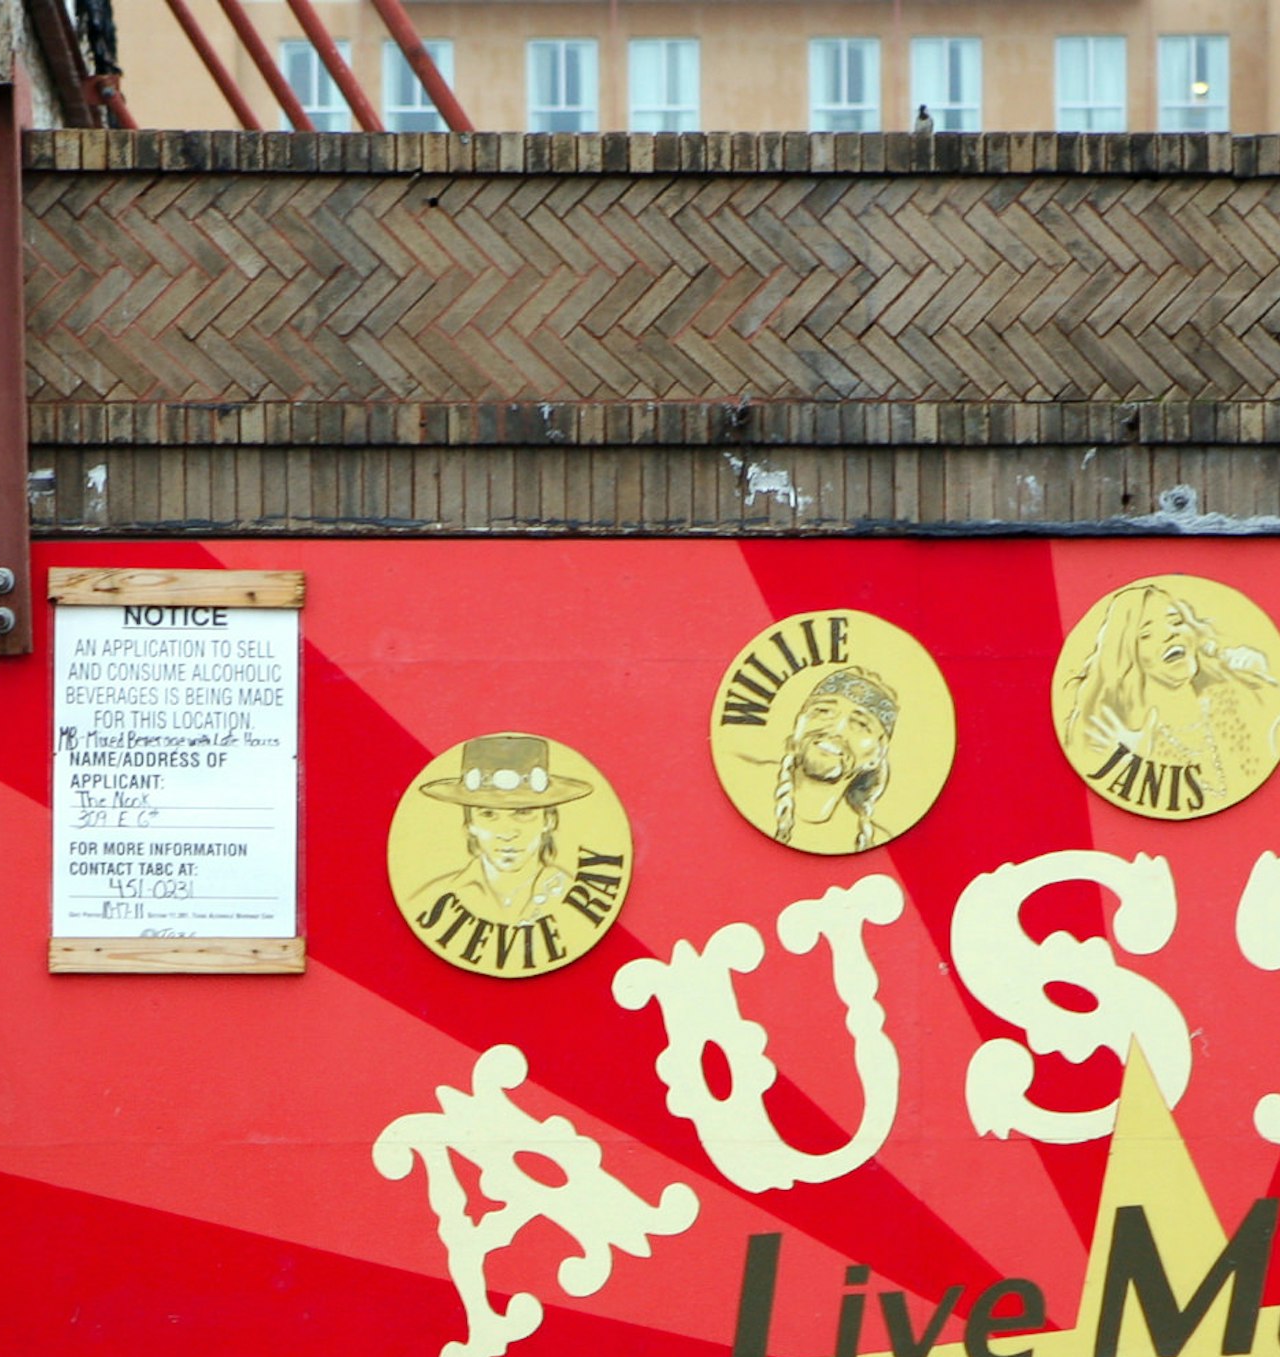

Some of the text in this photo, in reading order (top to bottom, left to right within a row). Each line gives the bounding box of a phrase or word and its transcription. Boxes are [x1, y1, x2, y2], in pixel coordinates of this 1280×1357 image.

[123, 606, 229, 627] NOTICE
[74, 639, 275, 658] AN APPLICATION TO SELL
[68, 663, 282, 682] AND CONSUME ALCOHOLIC
[721, 617, 849, 729] WILLIE
[66, 686, 284, 706] BEVERAGES IS BEING MADE
[94, 710, 255, 730] FOR THIS LOCATION.
[70, 752, 228, 767] NAME/ADDRESS OF
[70, 774, 165, 790] APPLICANT:
[1087, 742, 1206, 812] JANIS
[74, 790, 106, 808] The
[70, 842, 248, 857] FOR MORE INFORMATION
[69, 861, 198, 876] CONTACT TABC AT:
[416, 846, 624, 970] STEVIE RAY
